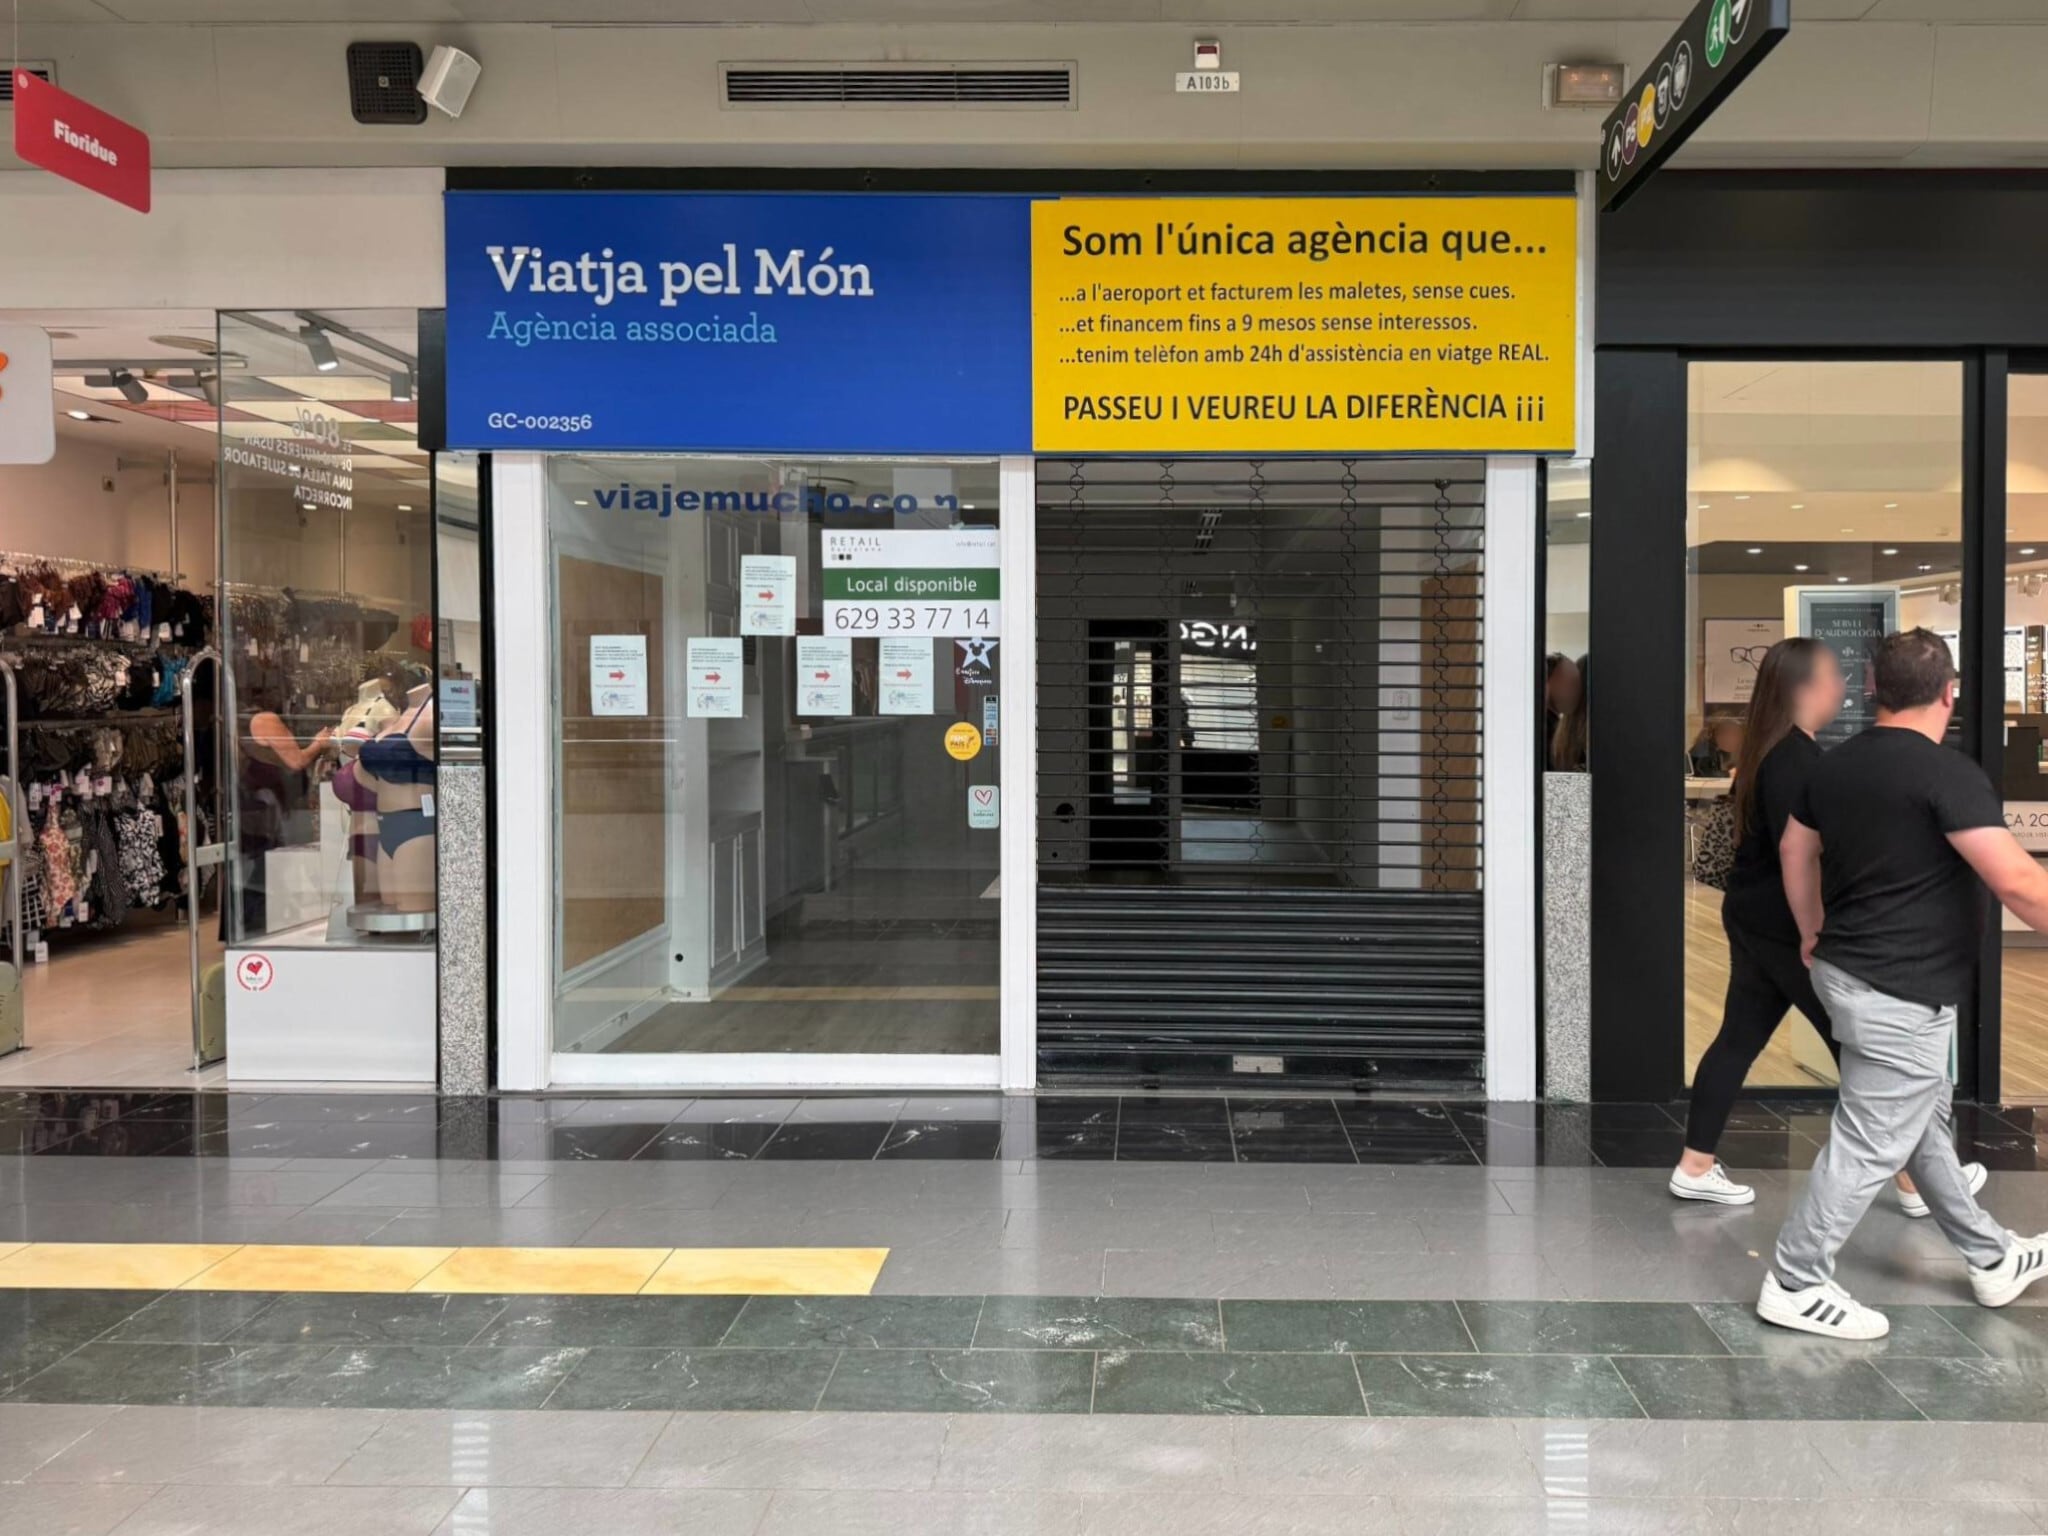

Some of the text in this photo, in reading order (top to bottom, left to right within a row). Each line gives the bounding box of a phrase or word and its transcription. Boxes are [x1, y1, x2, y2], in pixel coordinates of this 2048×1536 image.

[1186, 75, 1230, 90] A103b
[53, 118, 118, 167] Fioridue
[1062, 220, 1547, 262] Som l'única agència que...
[485, 243, 874, 307] Viatja pel Món
[1059, 281, 1516, 305] ...a l'aeroport et facturem les maletes, sense cues.
[486, 310, 778, 348] Agència associada
[1059, 312, 1478, 333] ...et financem fins a 9 mesos sense interessos.
[1059, 343, 1550, 365] ...tenim telèfon amb 24h d'assistència en viatge REAL.
[1063, 394, 1163, 421] PASSEU
[1172, 395, 1179, 420] I
[1187, 394, 1296, 421] VEUREU
[1305, 394, 1338, 420] LA
[1346, 386, 1508, 420] DIFERÈNCIA
[487, 411, 593, 432] GC-002356
[830, 536, 882, 546] RETAIL
[846, 576, 977, 596] Local disponible
[834, 607, 990, 630] 629 33 77 14
